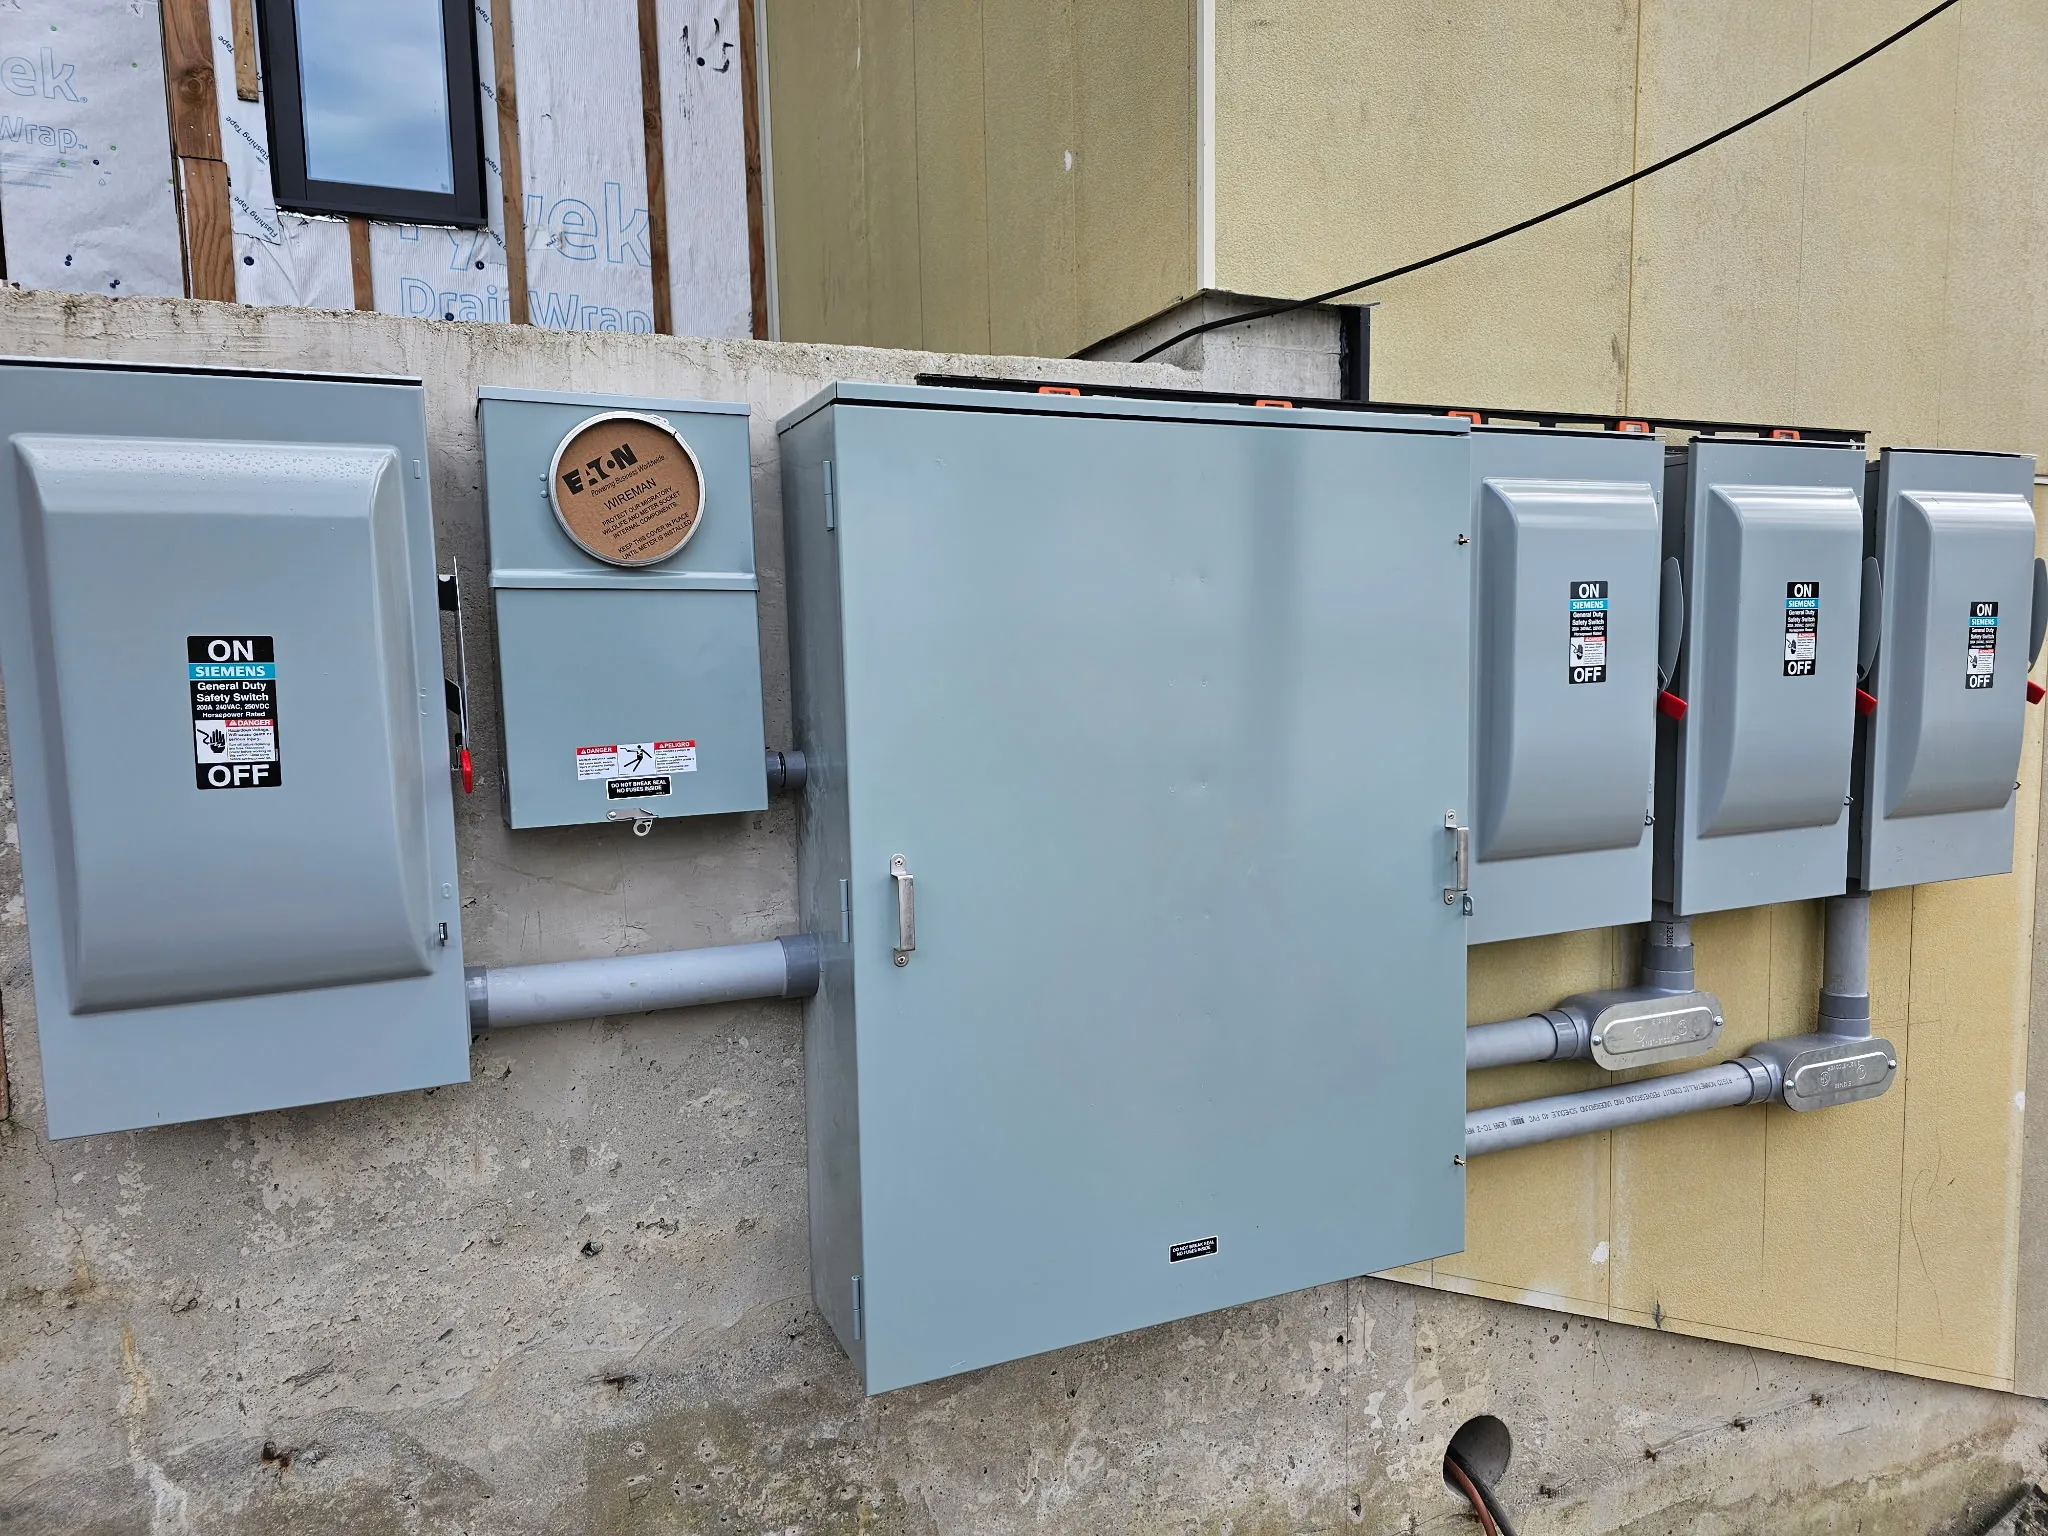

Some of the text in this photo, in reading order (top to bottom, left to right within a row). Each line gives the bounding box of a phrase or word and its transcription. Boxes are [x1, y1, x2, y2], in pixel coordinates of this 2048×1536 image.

[476, 6, 490, 23] Tape
[218, 36, 234, 54] Tape
[481, 82, 494, 99] Tape
[226, 116, 270, 160] Flashing Tape
[485, 157, 499, 174] Tape
[234, 196, 278, 238] Flashing Tape
[490, 230, 503, 246] Tape
[590, 455, 665, 497] Powering Business Worldwide
[604, 478, 657, 510] WIREMAN
[602, 486, 672, 526] PROTECT OUR MIGRATORY
[602, 491, 680, 536] WILDLIFE AND METER SOCKET
[613, 522, 640, 539] INTERNAL
[618, 543, 633, 553] KEEP
[633, 536, 647, 545] THIS
[646, 525, 665, 538] COVER
[672, 512, 689, 524] PLACE
[622, 549, 639, 560] UNTIL
[638, 538, 657, 552] METER
[664, 519, 692, 538] INSTALLED
[1579, 583, 1600, 598] ON
[1794, 583, 1812, 597] ON
[1572, 601, 1604, 609] SIEMENS
[1788, 600, 1815, 608] SIEMENS
[1977, 603, 1992, 616] ON
[207, 639, 254, 662] ON
[195, 665, 266, 677] SIEMENS
[1574, 667, 1602, 682] OFF
[1788, 661, 1812, 675] OFF
[197, 681, 267, 692] General Duty
[1969, 675, 1991, 688] OFF
[196, 692, 269, 704] Safety Switch
[208, 764, 270, 787] OFF
[1684, 1081, 1717, 1092] NONMETALLIC
[1717, 1078, 1733, 1086] RIGID
[1626, 1091, 1661, 1103] ABOVEGROUND
[1663, 1087, 1682, 1097] CONDUIT
[1580, 1100, 1612, 1113] UNDERGROUND
[1614, 1098, 1624, 1106] AND
[1529, 1115, 1540, 1123] PVC
[1552, 1108, 1578, 1118] SCHEDULE
